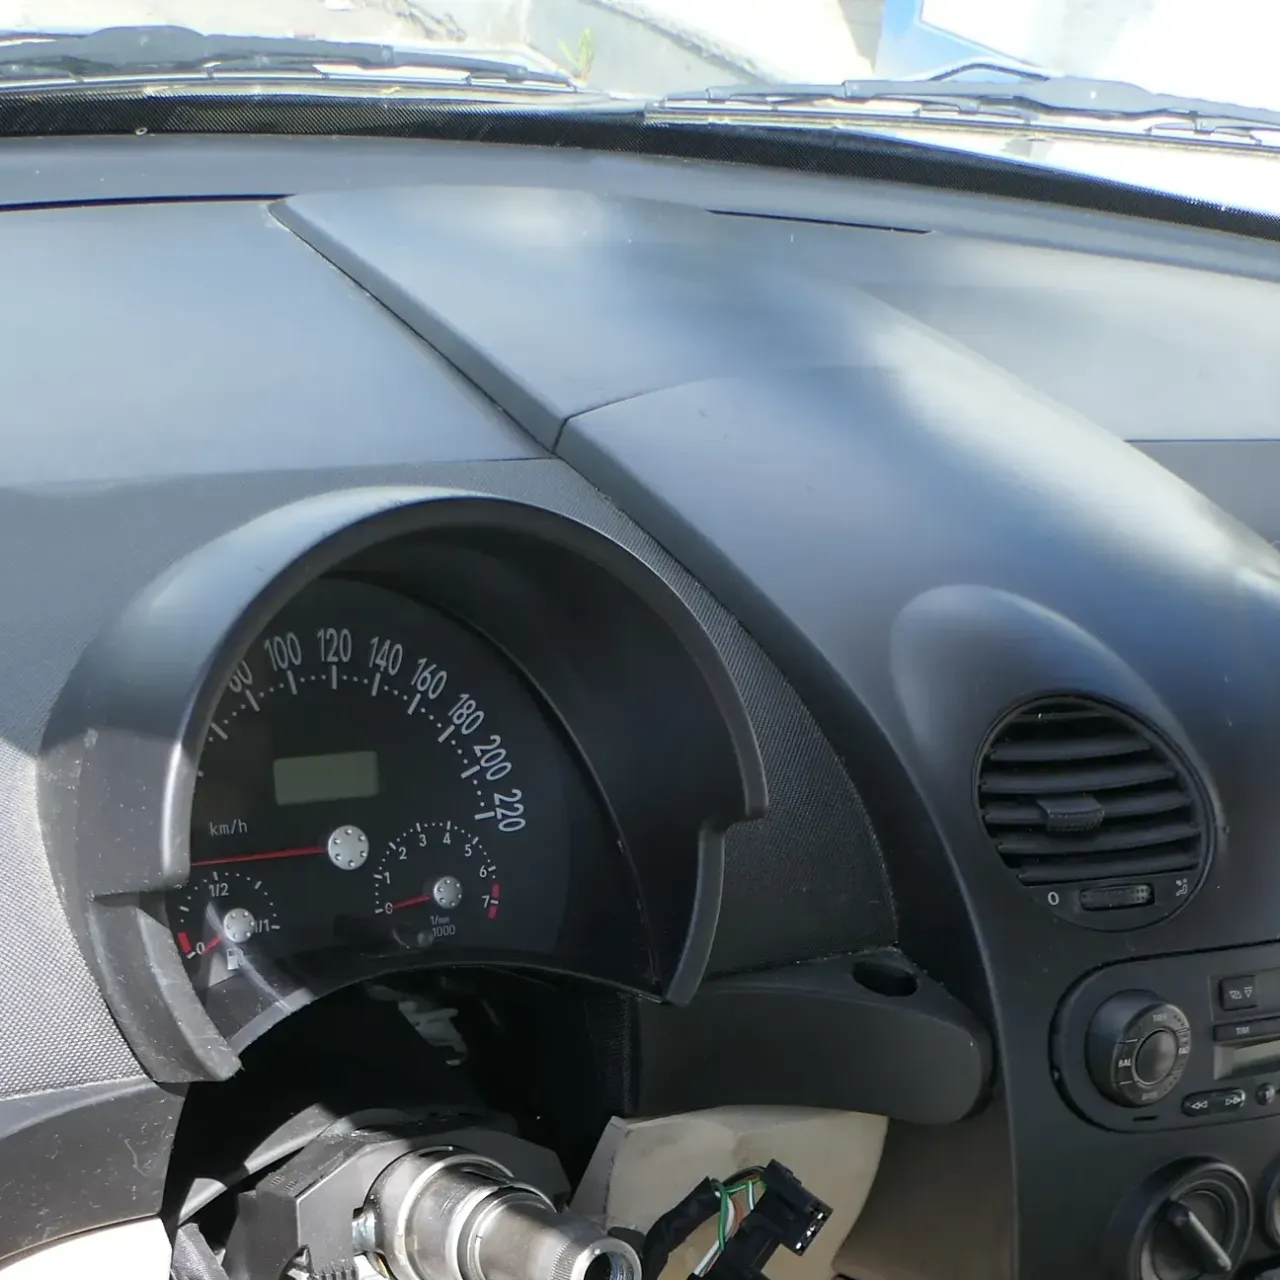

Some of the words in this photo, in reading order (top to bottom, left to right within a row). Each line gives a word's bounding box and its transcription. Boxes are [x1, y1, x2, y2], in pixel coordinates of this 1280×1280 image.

[264, 631, 302, 672] 100
[317, 627, 352, 663] 120
[368, 636, 403, 676] 140
[411, 657, 447, 700] 160
[448, 693, 485, 735] 180
[473, 735, 512, 781] 200
[493, 788, 526, 832] 220
[209, 818, 248, 836] km/h
[419, 834, 427, 847] 3
[442, 832, 451, 845] 4
[398, 847, 407, 860] 2
[464, 843, 472, 857] 5
[383, 872, 391, 884] 1
[479, 865, 487, 878] 6
[208, 882, 230, 897] 1/2
[384, 902, 393, 914] 0
[481, 895, 490, 908] 7
[432, 924, 456, 937] 1000
[196, 941, 205, 955] 0
